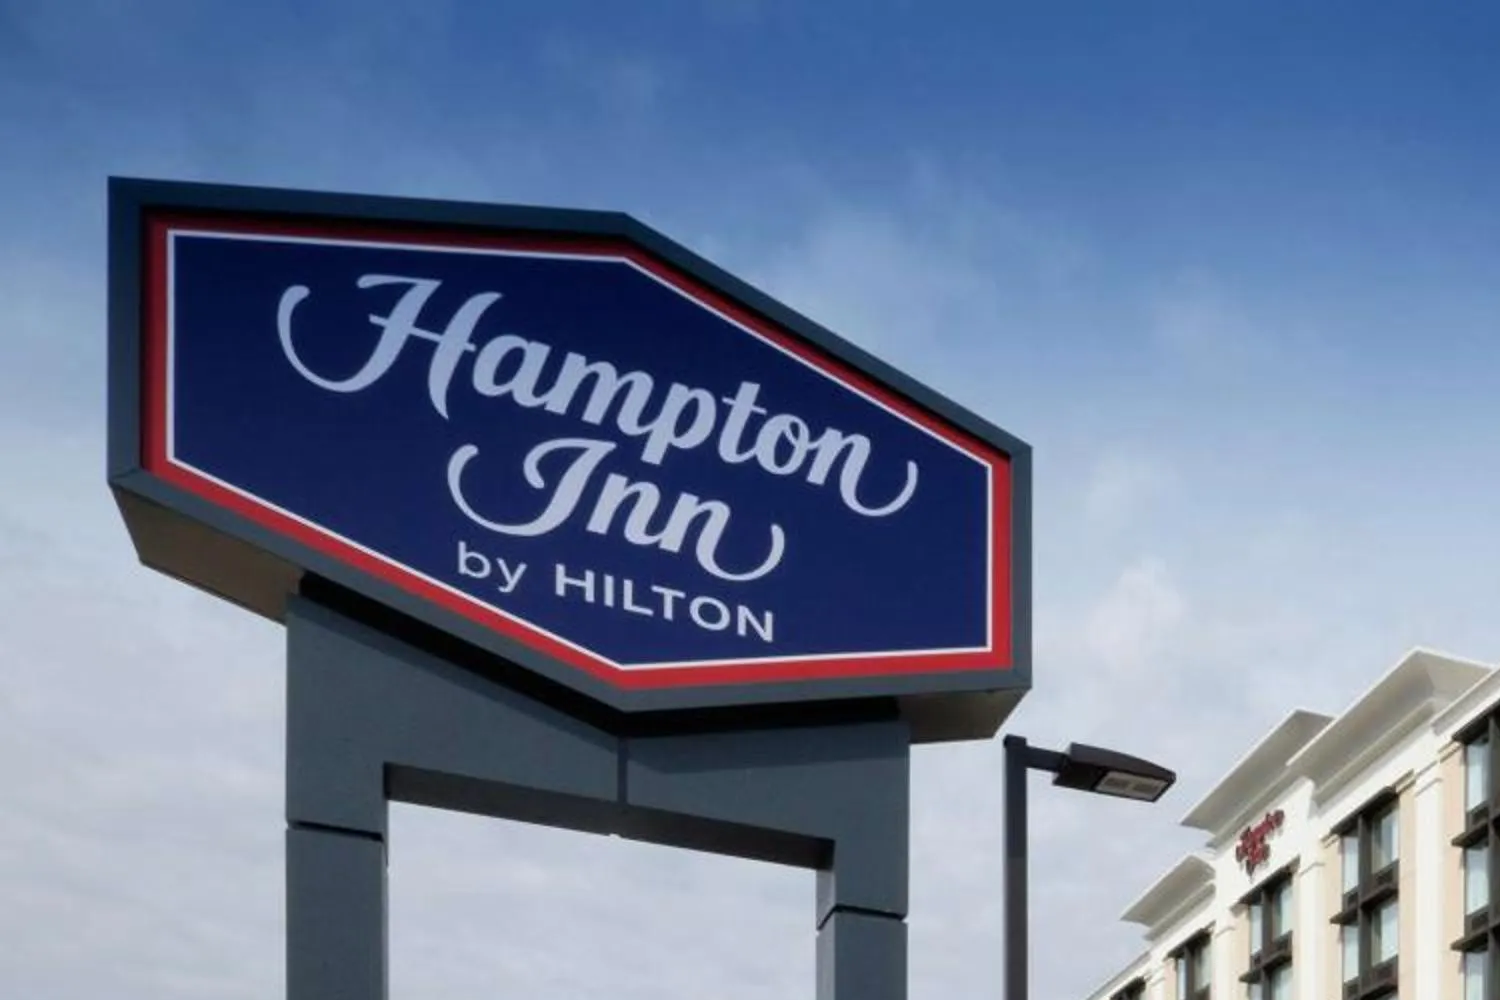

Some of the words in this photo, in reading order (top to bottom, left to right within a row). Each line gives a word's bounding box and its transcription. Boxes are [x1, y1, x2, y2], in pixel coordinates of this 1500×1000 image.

[277, 273, 919, 518] Hampton
[446, 437, 786, 582] Inn
[457, 541, 528, 594] by
[554, 562, 776, 644] HILTON
